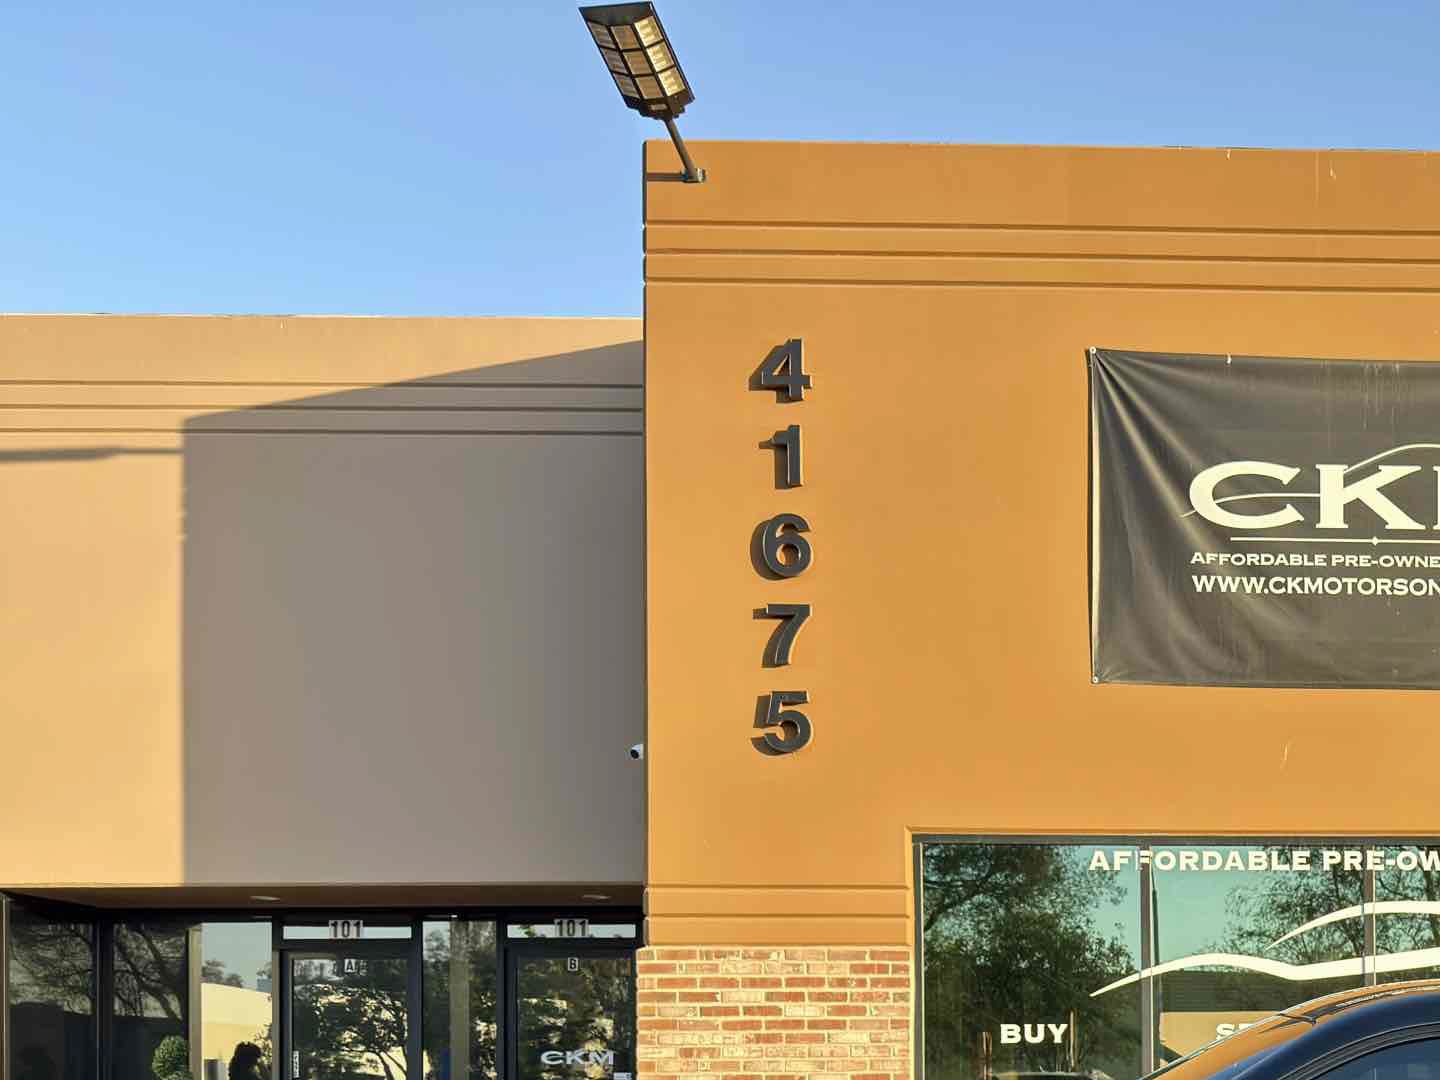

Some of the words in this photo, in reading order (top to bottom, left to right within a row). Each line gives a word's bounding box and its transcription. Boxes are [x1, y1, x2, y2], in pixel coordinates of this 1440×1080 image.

[1190, 551, 1327, 567] AFFORDABLE
[1088, 850, 1312, 871] AFFORDABLE
[329, 920, 362, 938] 101
[556, 920, 588, 937] 101
[1000, 1023, 1069, 1044] BUY
[540, 1050, 614, 1065] CKM
